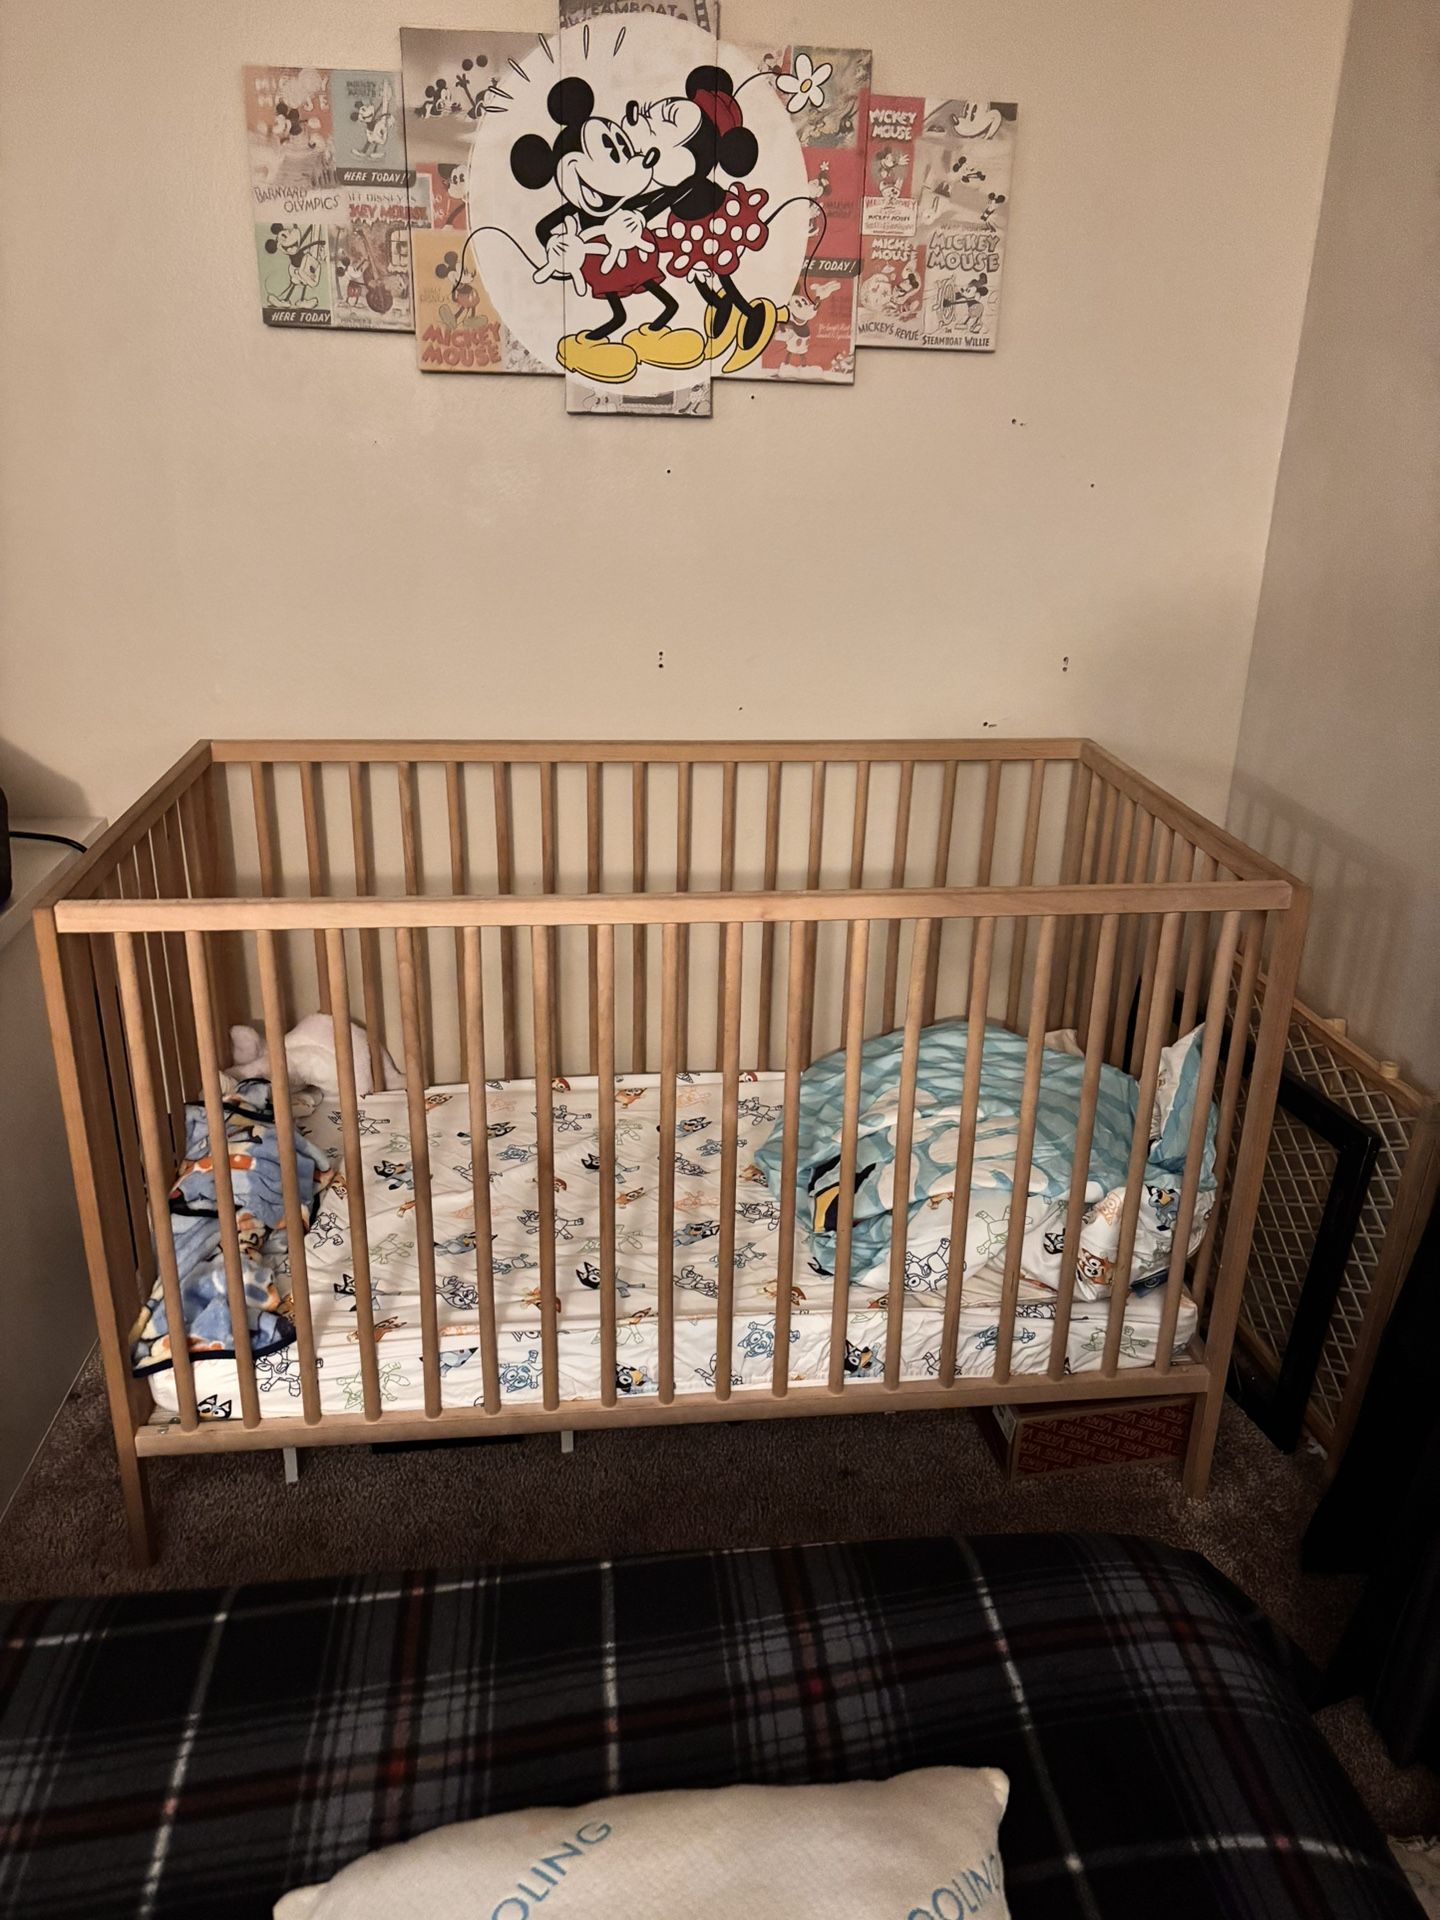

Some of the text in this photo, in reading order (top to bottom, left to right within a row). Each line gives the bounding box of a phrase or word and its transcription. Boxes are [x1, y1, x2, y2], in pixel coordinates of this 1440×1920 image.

[869, 108, 917, 125] MICKEY
[872, 124, 912, 140] MOUSE
[343, 171, 367, 181] HERE
[253, 186, 308, 204] BARNYARD
[284, 195, 339, 213] OLYMPICS
[872, 238, 912, 251] MICKE
[929, 231, 1001, 252] MICKEY
[819, 260, 856, 273] TODAY!
[927, 250, 1000, 272] MOUSE
[271, 312, 331, 322] HERE TODAY
[422, 321, 501, 348] MICKEY
[858, 322, 894, 335] MICKEY'S
[895, 328, 919, 341] REVUE
[922, 335, 990, 347] STEAMBOAT WILLIE
[421, 343, 502, 367] MOUSE
[1089, 1432, 1120, 1450] VANS
